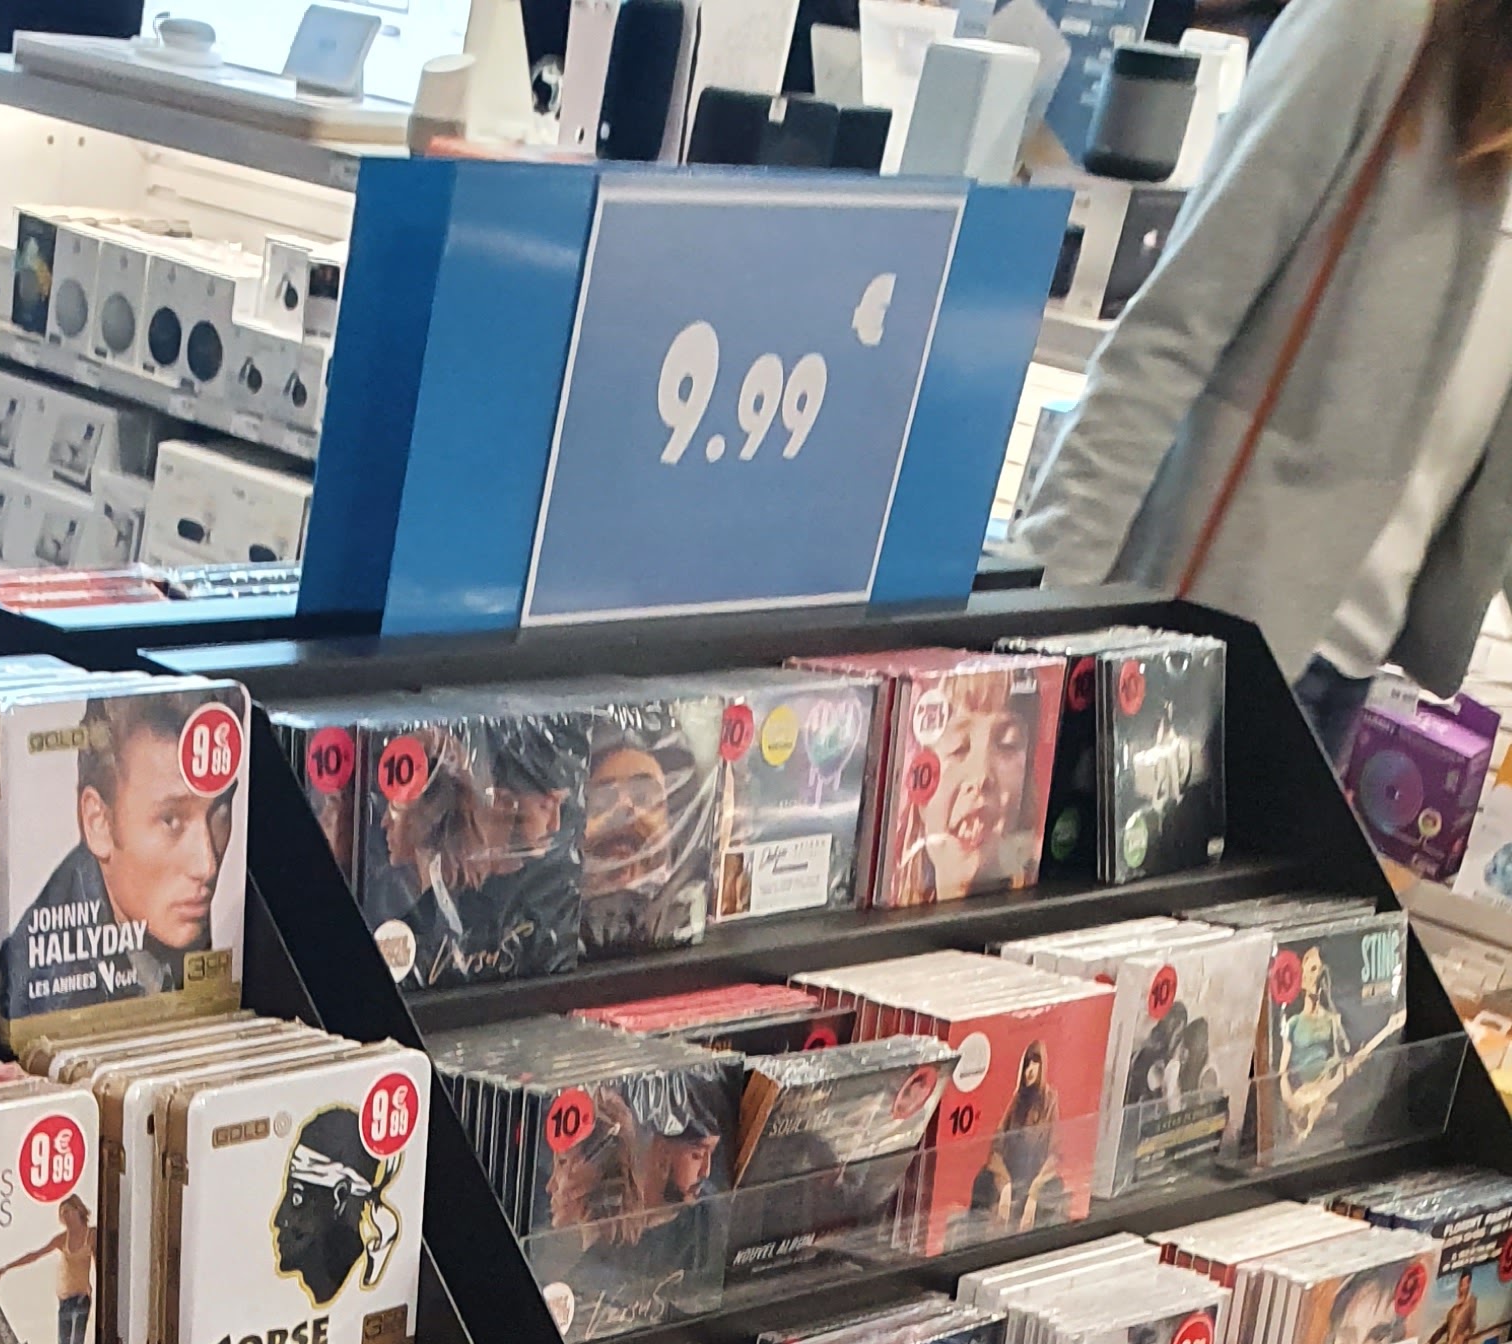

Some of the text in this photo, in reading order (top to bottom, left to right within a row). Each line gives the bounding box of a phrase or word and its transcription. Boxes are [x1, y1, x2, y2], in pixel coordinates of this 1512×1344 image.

[28, 730, 86, 755] GOLD
[27, 899, 102, 934] JOHNNY
[28, 919, 148, 969] HALLYDAY
[213, 1118, 270, 1147] GOLD
